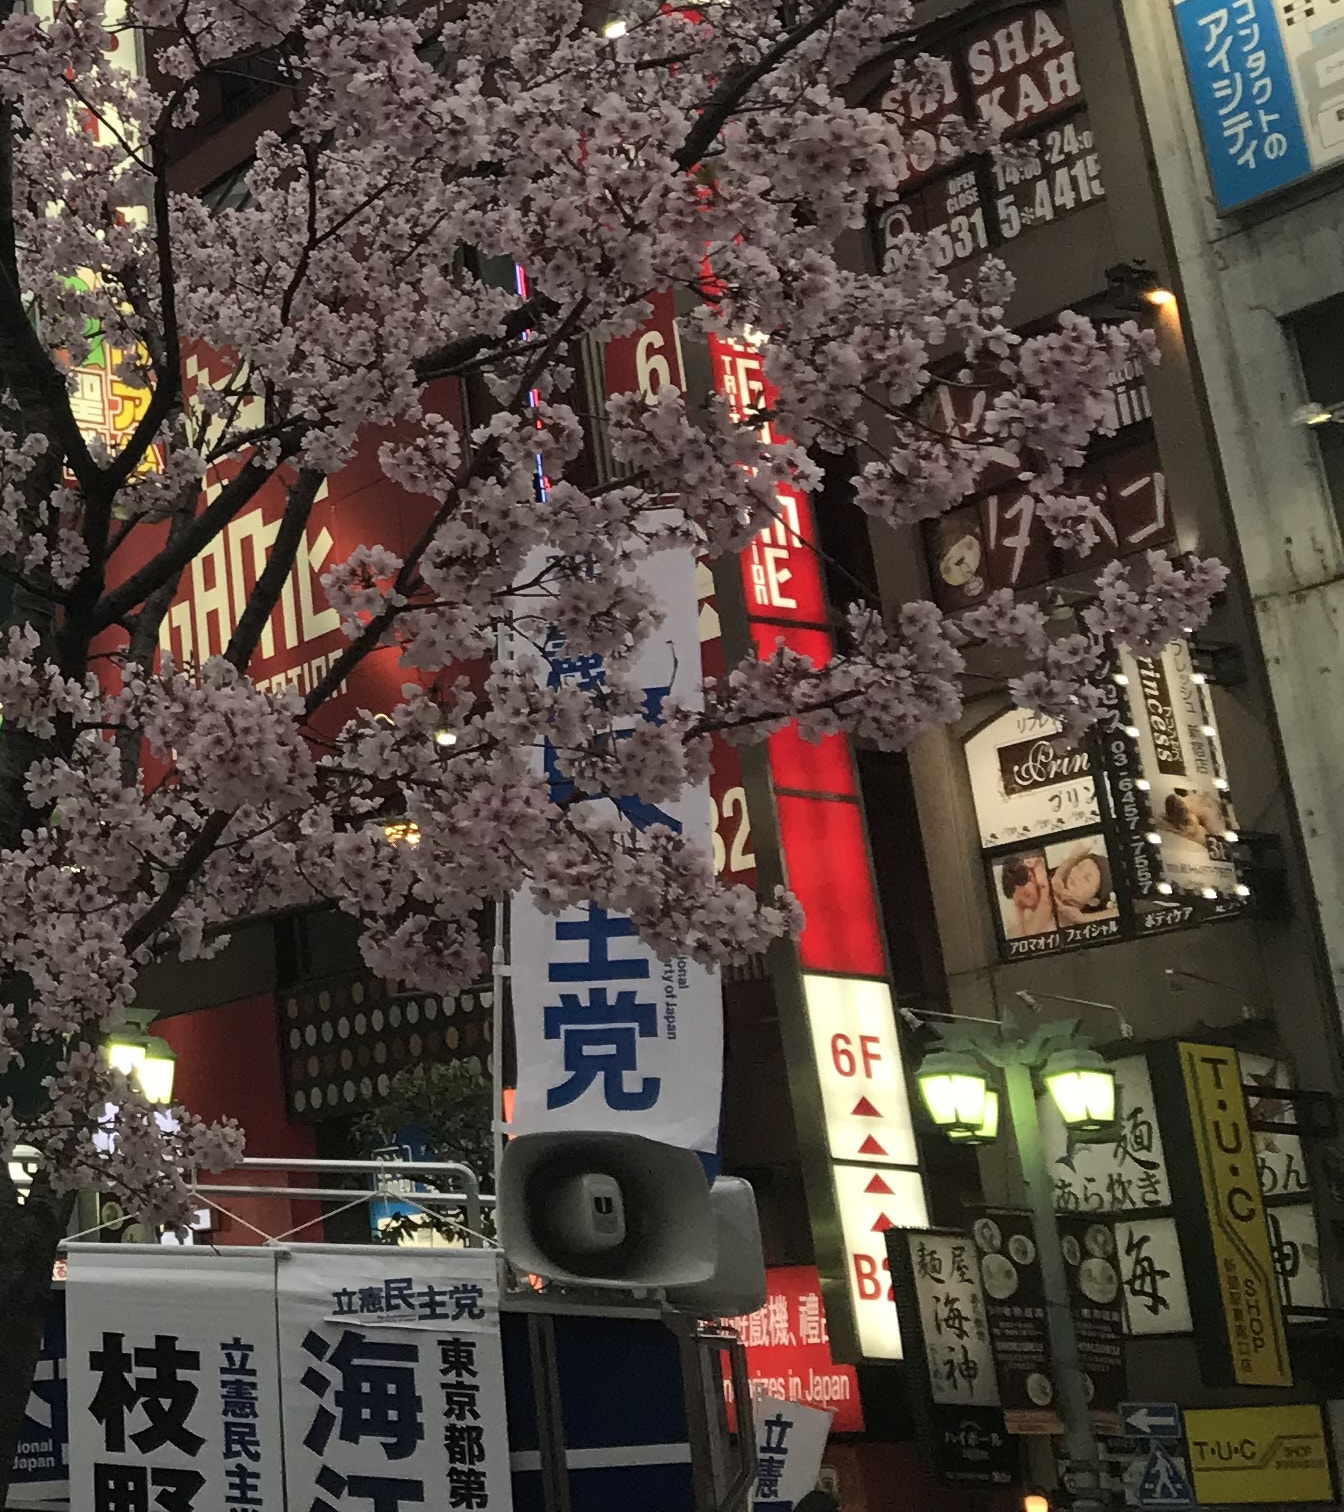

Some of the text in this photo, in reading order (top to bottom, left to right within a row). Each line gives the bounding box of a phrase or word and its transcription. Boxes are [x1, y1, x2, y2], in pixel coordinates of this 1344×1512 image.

[967, 8, 1065, 86] SHA
[1197, 7, 1258, 170] アイシティ
[1139, 654, 1174, 763] rincess
[1065, 920, 1118, 943] フェイシャル
[1144, 906, 1194, 930] ボディケア
[831, 1033, 883, 1080] 6F
[331, 1276, 486, 1321] 立憲民主党
[805, 1367, 851, 1410] Japan
[219, 1336, 265, 1512] 立憲民主
[436, 1337, 490, 1511] 東京都第
